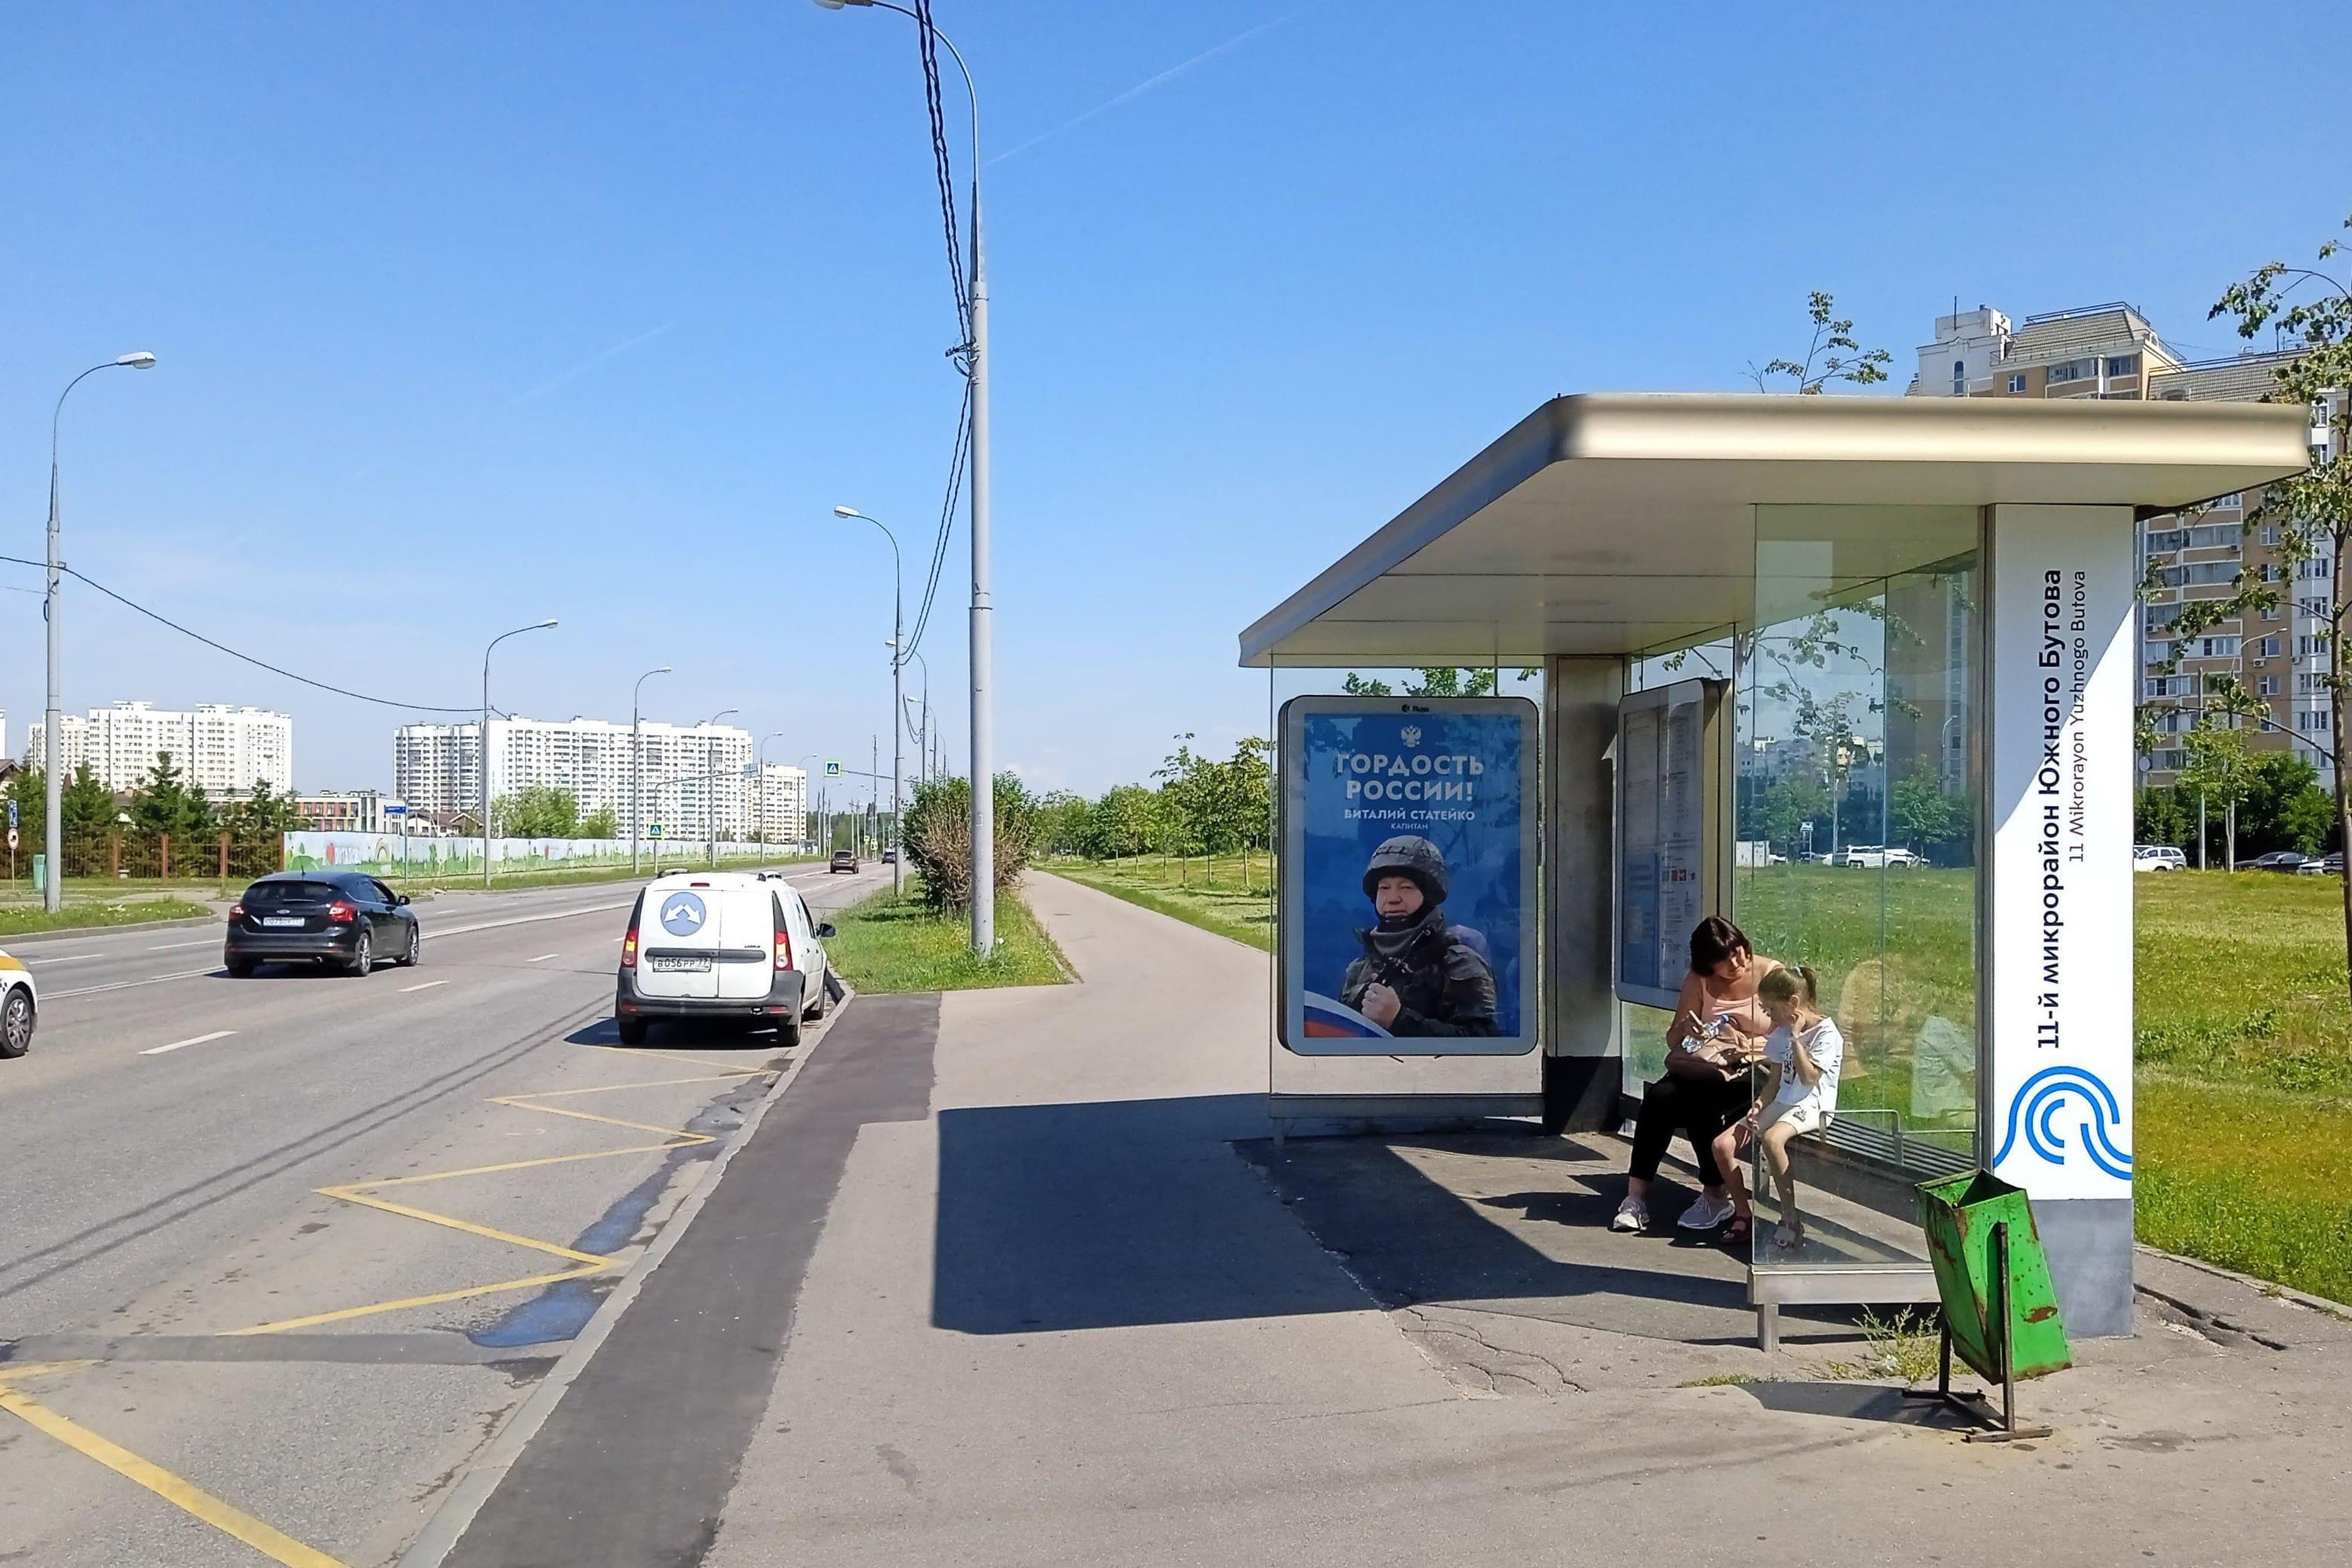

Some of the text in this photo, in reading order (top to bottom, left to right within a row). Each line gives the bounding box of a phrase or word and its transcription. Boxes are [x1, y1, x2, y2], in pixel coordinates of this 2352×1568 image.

[2068, 570, 2088, 862] 11 Mikrorayon Yuzhnogo Butova
[1337, 754, 1484, 776] ГОРДОСТЬ
[1346, 780, 1473, 801] РОССИИ!
[1344, 808, 1475, 821] ВИТАЛИЙ СТАТЕЙКО
[2038, 570, 2065, 1049] 11-й микрорайон Южного Бутова
